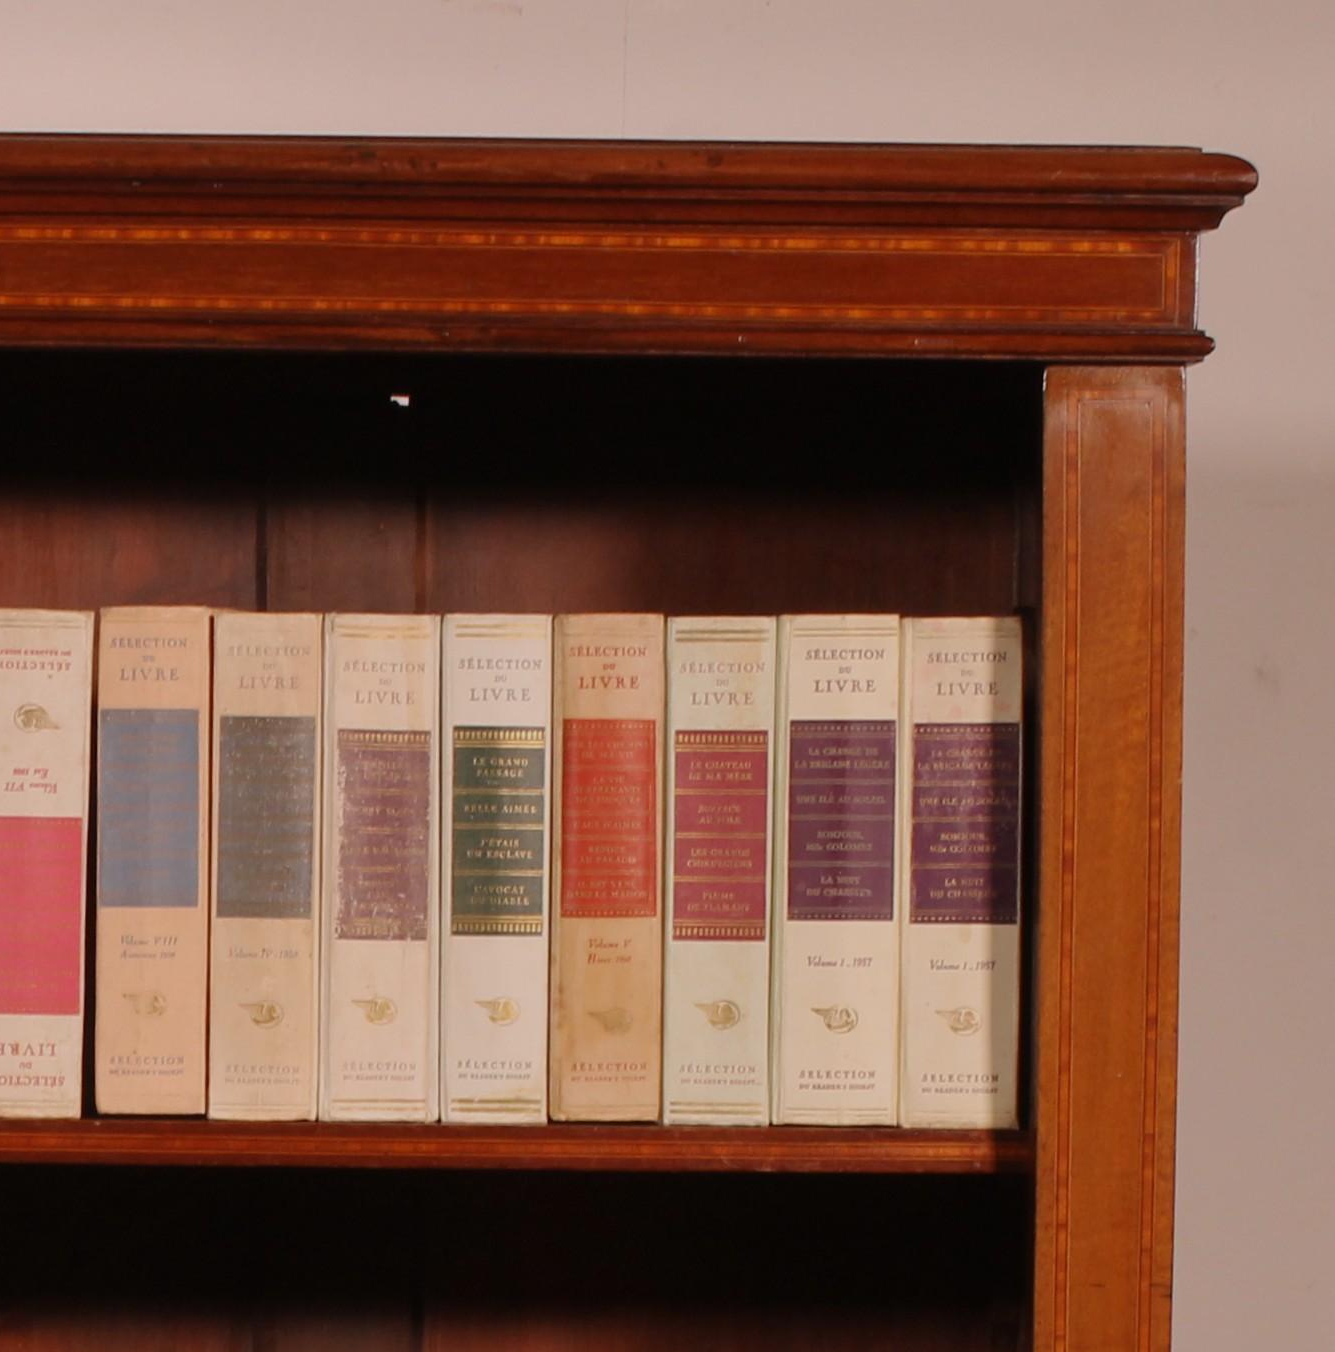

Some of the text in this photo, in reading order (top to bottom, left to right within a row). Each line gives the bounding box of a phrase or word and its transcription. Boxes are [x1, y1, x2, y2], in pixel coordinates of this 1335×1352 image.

[569, 645, 647, 657] SÉLECTION
[805, 648, 885, 660] SÉLECTION
[927, 651, 1008, 664] SÉLECTION
[343, 660, 425, 673] SÉLECTION
[458, 657, 542, 670] SÉLECTION
[680, 662, 765, 674] SÉLECTION
[119, 668, 179, 681] LIVRE
[238, 676, 300, 690] LIVRE
[579, 676, 640, 689] LIVRE
[814, 679, 876, 693] LIVRE
[936, 682, 1000, 696] LIVRE
[355, 691, 415, 705] LIVRE
[469, 689, 531, 702] LIVRE
[692, 692, 754, 706] LIVRE
[473, 757, 528, 766] LE GRAND
[476, 769, 524, 778] PASSAGE
